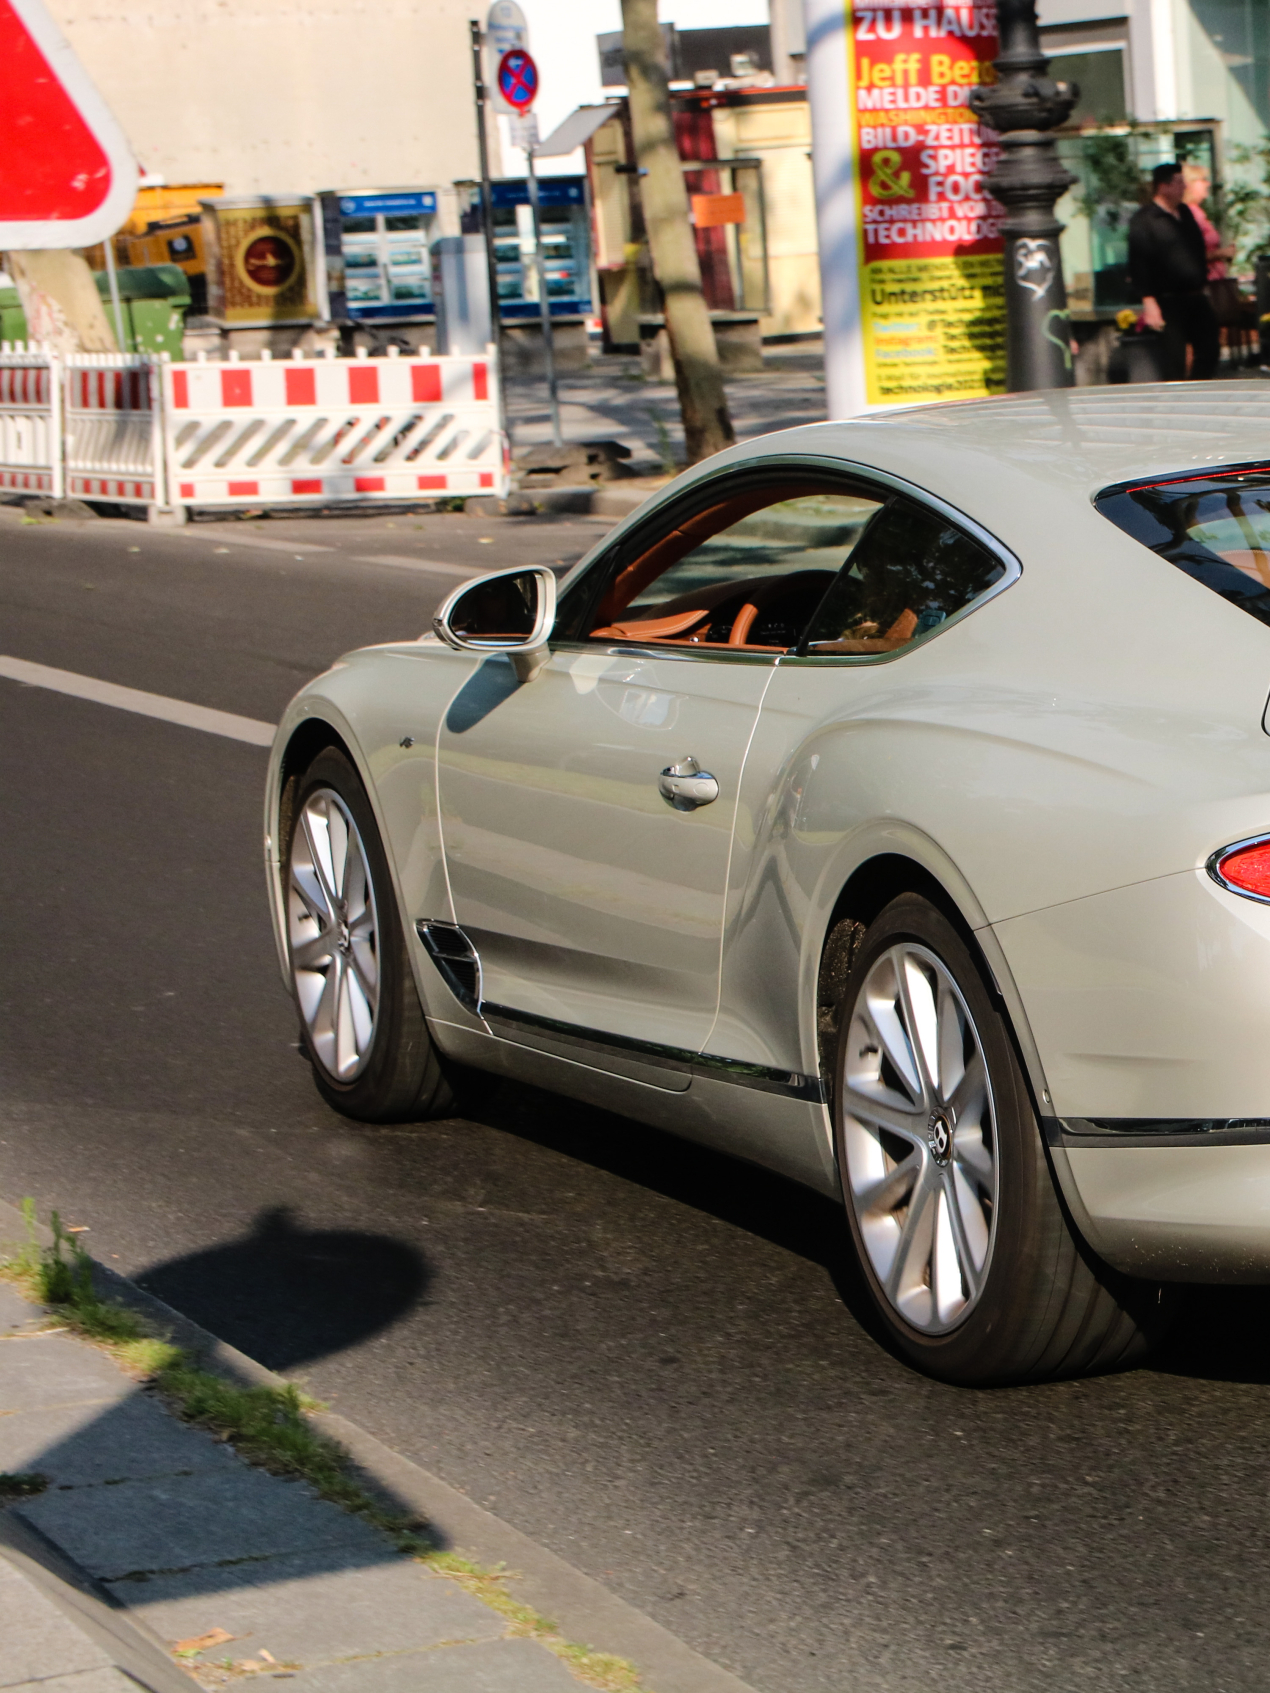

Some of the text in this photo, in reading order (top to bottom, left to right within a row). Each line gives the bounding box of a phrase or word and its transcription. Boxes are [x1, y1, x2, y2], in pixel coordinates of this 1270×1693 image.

[855, 10, 903, 41] ZU
[857, 53, 999, 87] Jeff Bezo
[857, 86, 943, 110] MELDE
[869, 149, 915, 198] &
[927, 173, 994, 203] FOC
[863, 202, 951, 223] SCHREIBT
[863, 218, 1003, 244] TECHNOLOG
[871, 283, 976, 305] Unterstütz
